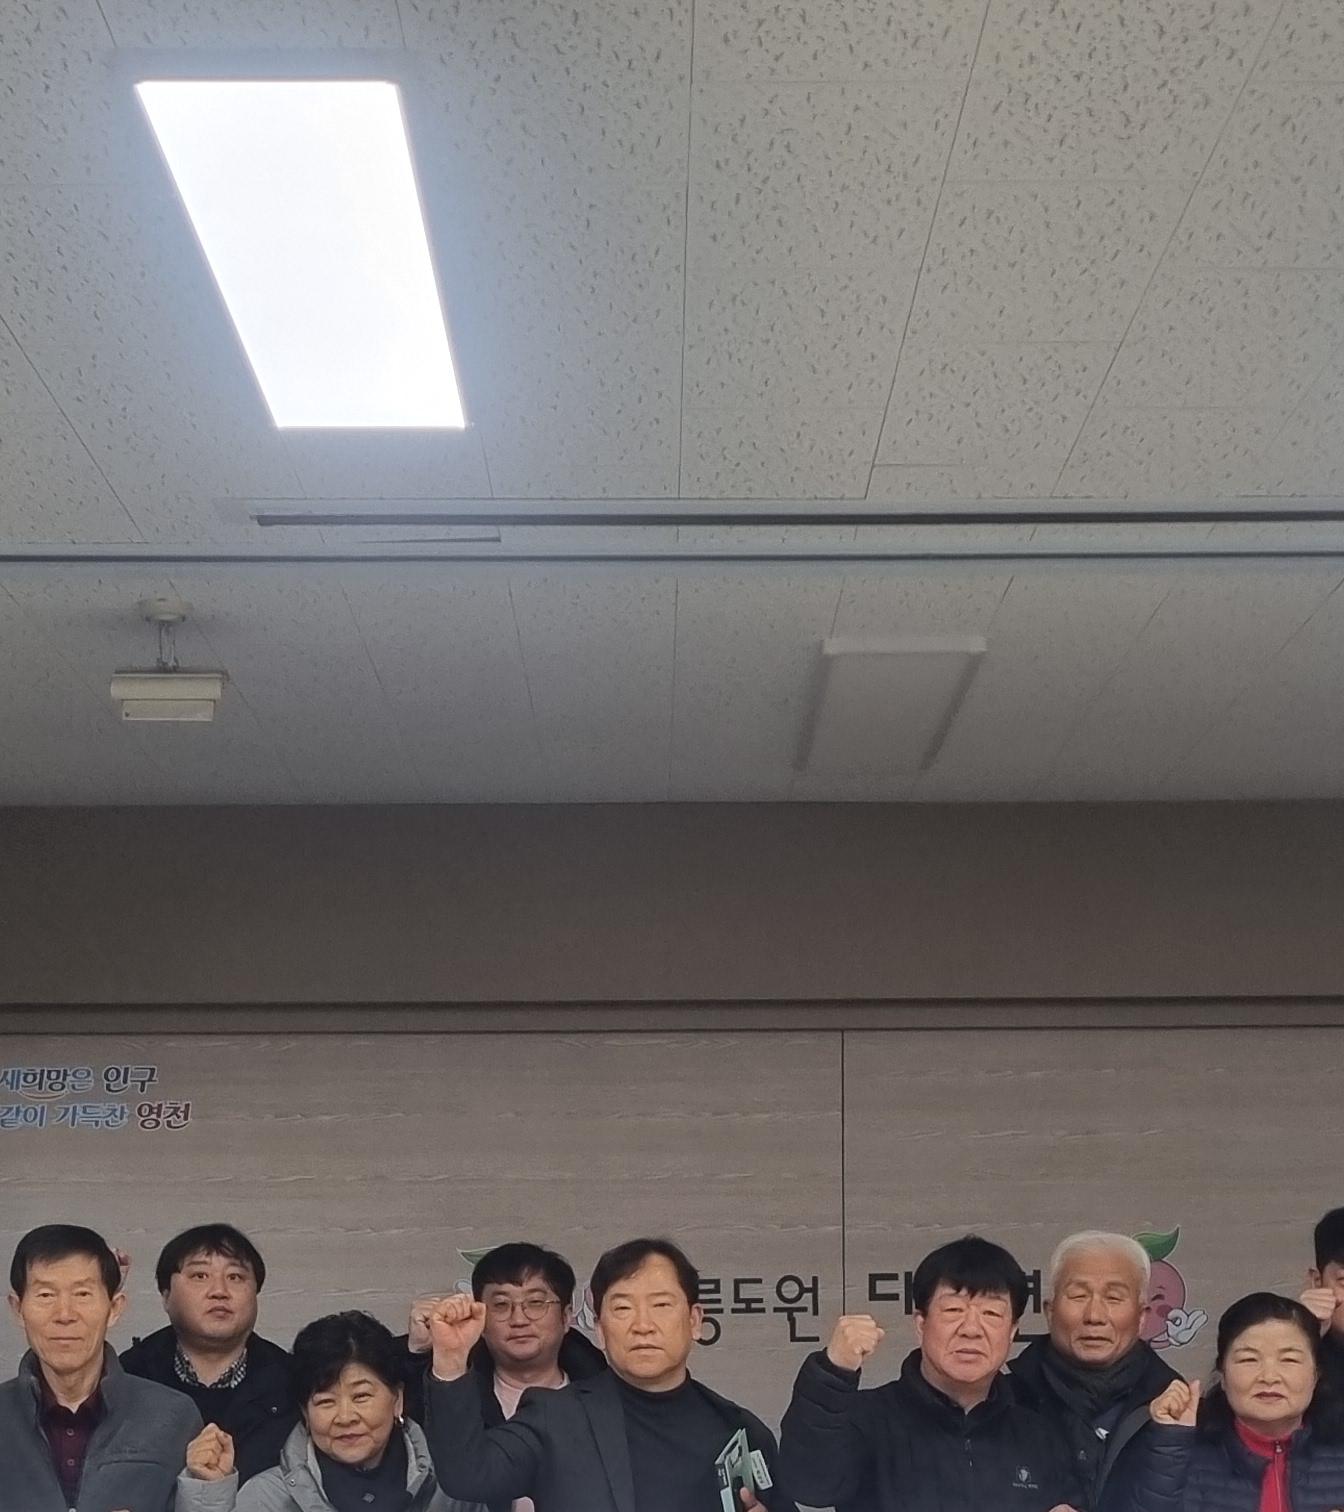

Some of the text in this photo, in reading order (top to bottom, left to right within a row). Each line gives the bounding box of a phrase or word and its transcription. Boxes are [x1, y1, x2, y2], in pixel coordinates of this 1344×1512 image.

[103, 1066, 158, 1094] 인구
[56, 1104, 128, 1129] 가득찬
[137, 1102, 192, 1130] 영천
[696, 1274, 820, 1346] 릉도원
